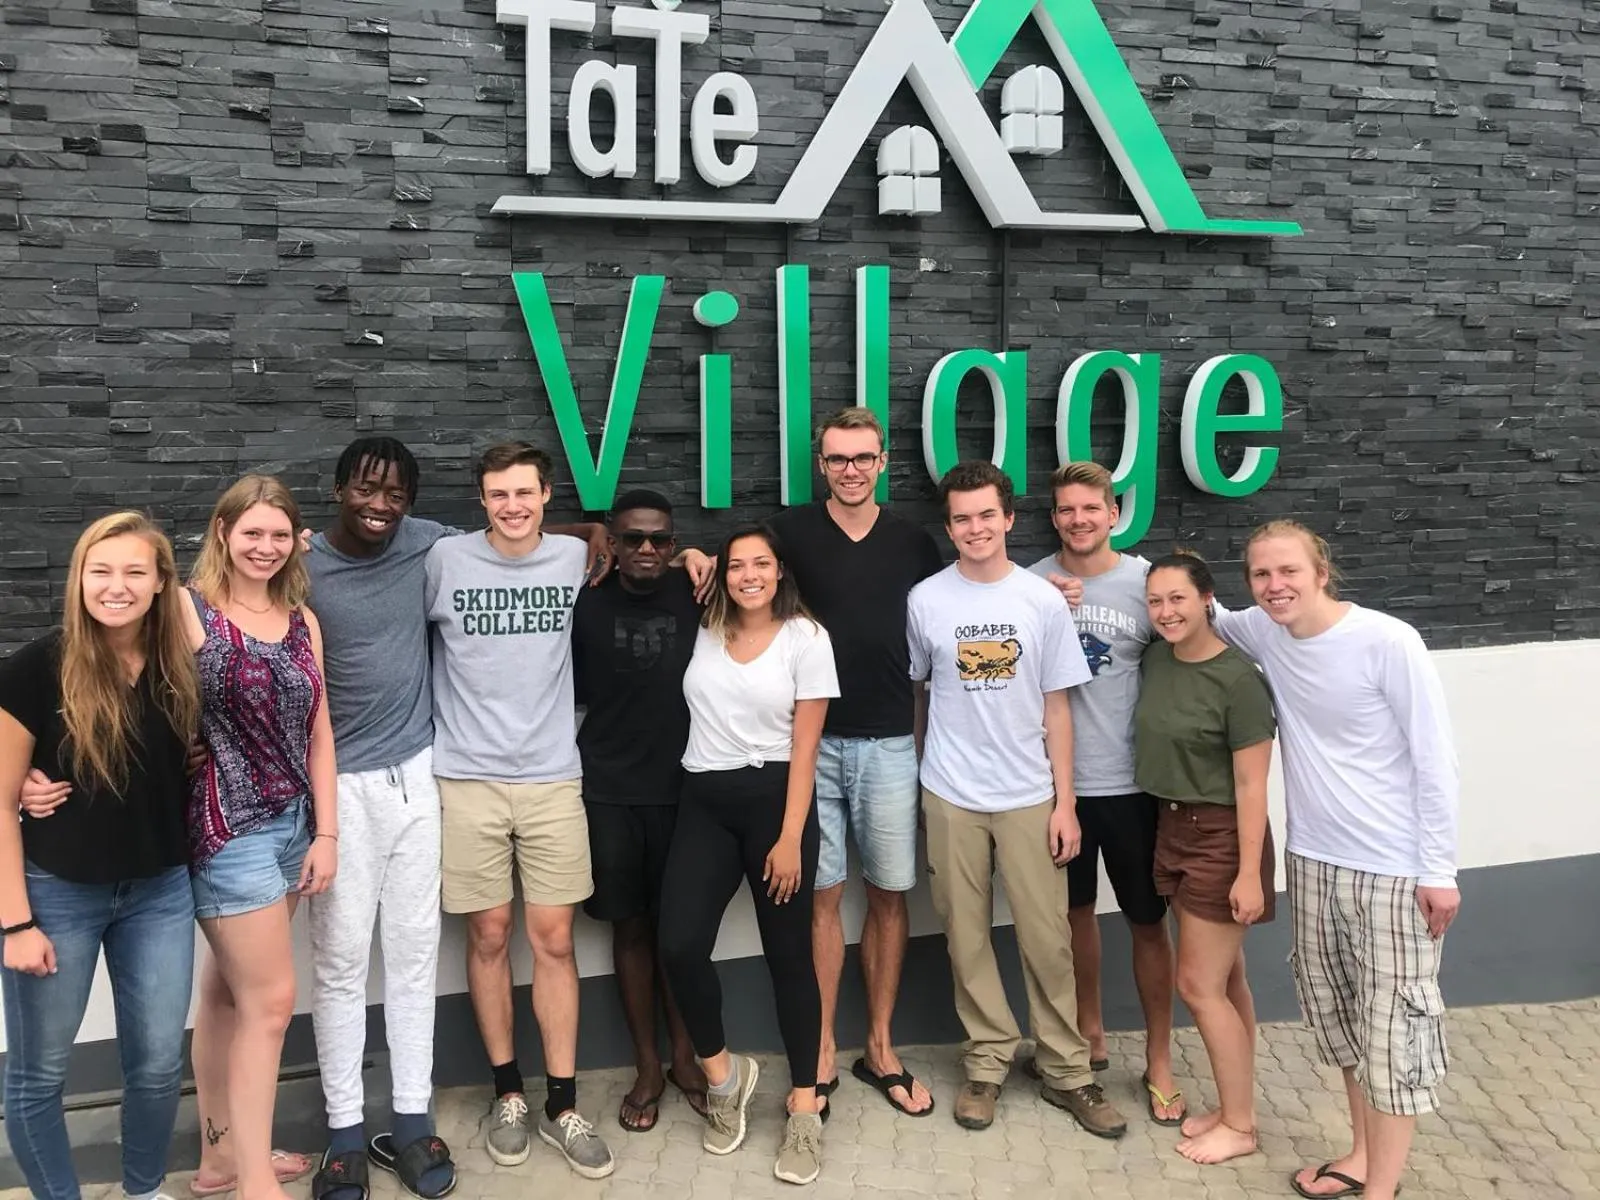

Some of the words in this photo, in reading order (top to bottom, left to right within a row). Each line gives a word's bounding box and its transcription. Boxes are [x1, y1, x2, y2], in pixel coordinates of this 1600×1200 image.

[512, 264, 1284, 550] Village
[453, 586, 574, 612] SKIDMORE
[463, 610, 565, 636] COLLEGE
[955, 624, 1018, 639] GOBABEB
